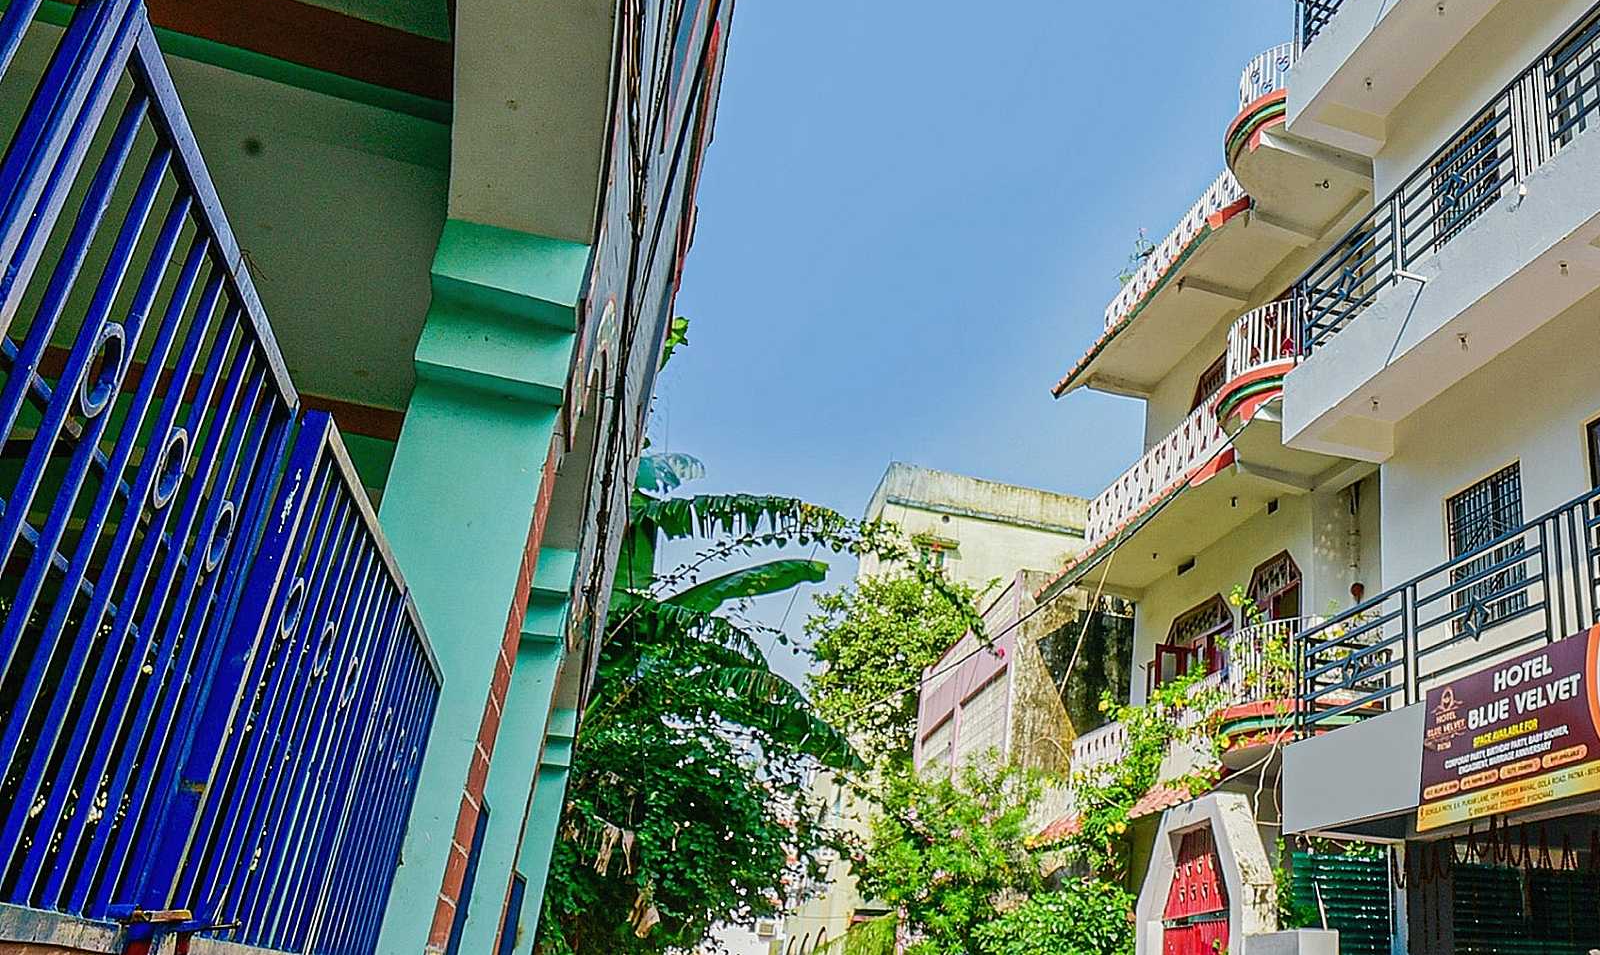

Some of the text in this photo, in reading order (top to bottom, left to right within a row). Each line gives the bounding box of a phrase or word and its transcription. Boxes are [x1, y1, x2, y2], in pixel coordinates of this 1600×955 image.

[1494, 654, 1553, 692] HOTEL
[1468, 673, 1581, 730] BLUE VELVET
[1427, 718, 1466, 738] BLUE VELVET
[1436, 711, 1457, 724] HOTEL
[1473, 718, 1538, 748] SPACE AVAILABLE FOR
[1528, 732, 1544, 745] BABY
